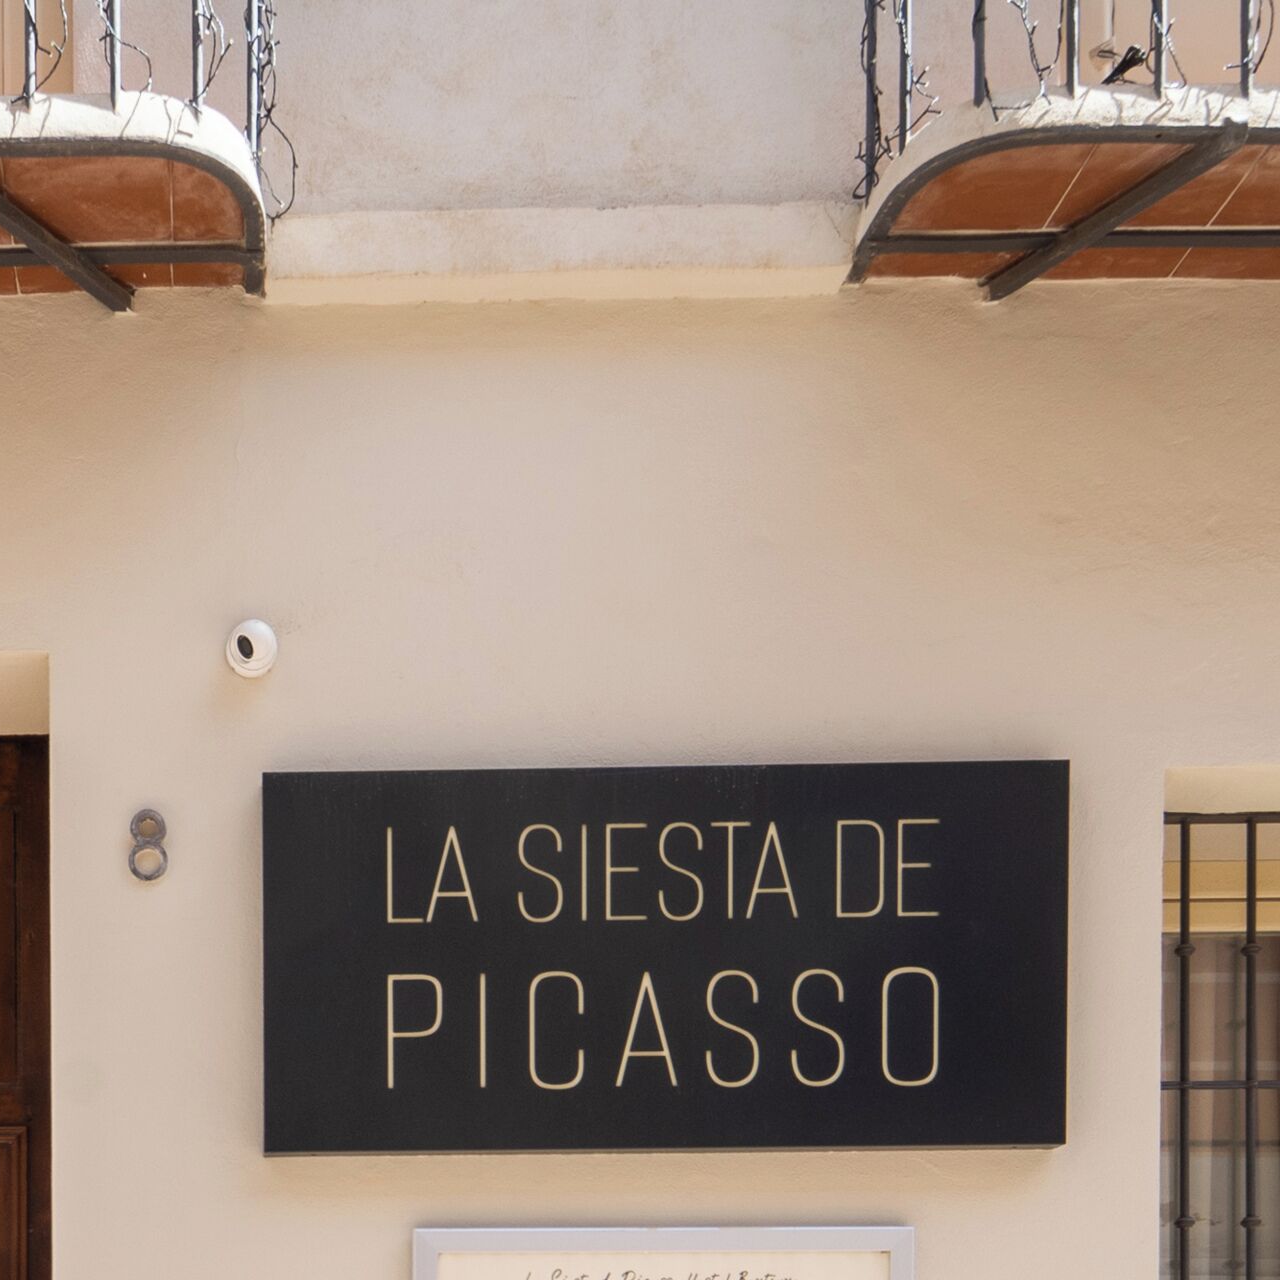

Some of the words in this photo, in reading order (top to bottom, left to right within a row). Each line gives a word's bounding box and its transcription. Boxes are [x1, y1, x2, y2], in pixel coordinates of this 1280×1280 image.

[128, 808, 168, 881] 8
[387, 826, 479, 924] LA
[518, 822, 798, 923] SIESTA
[837, 818, 940, 918] DE
[387, 966, 940, 1090] PICASSO
